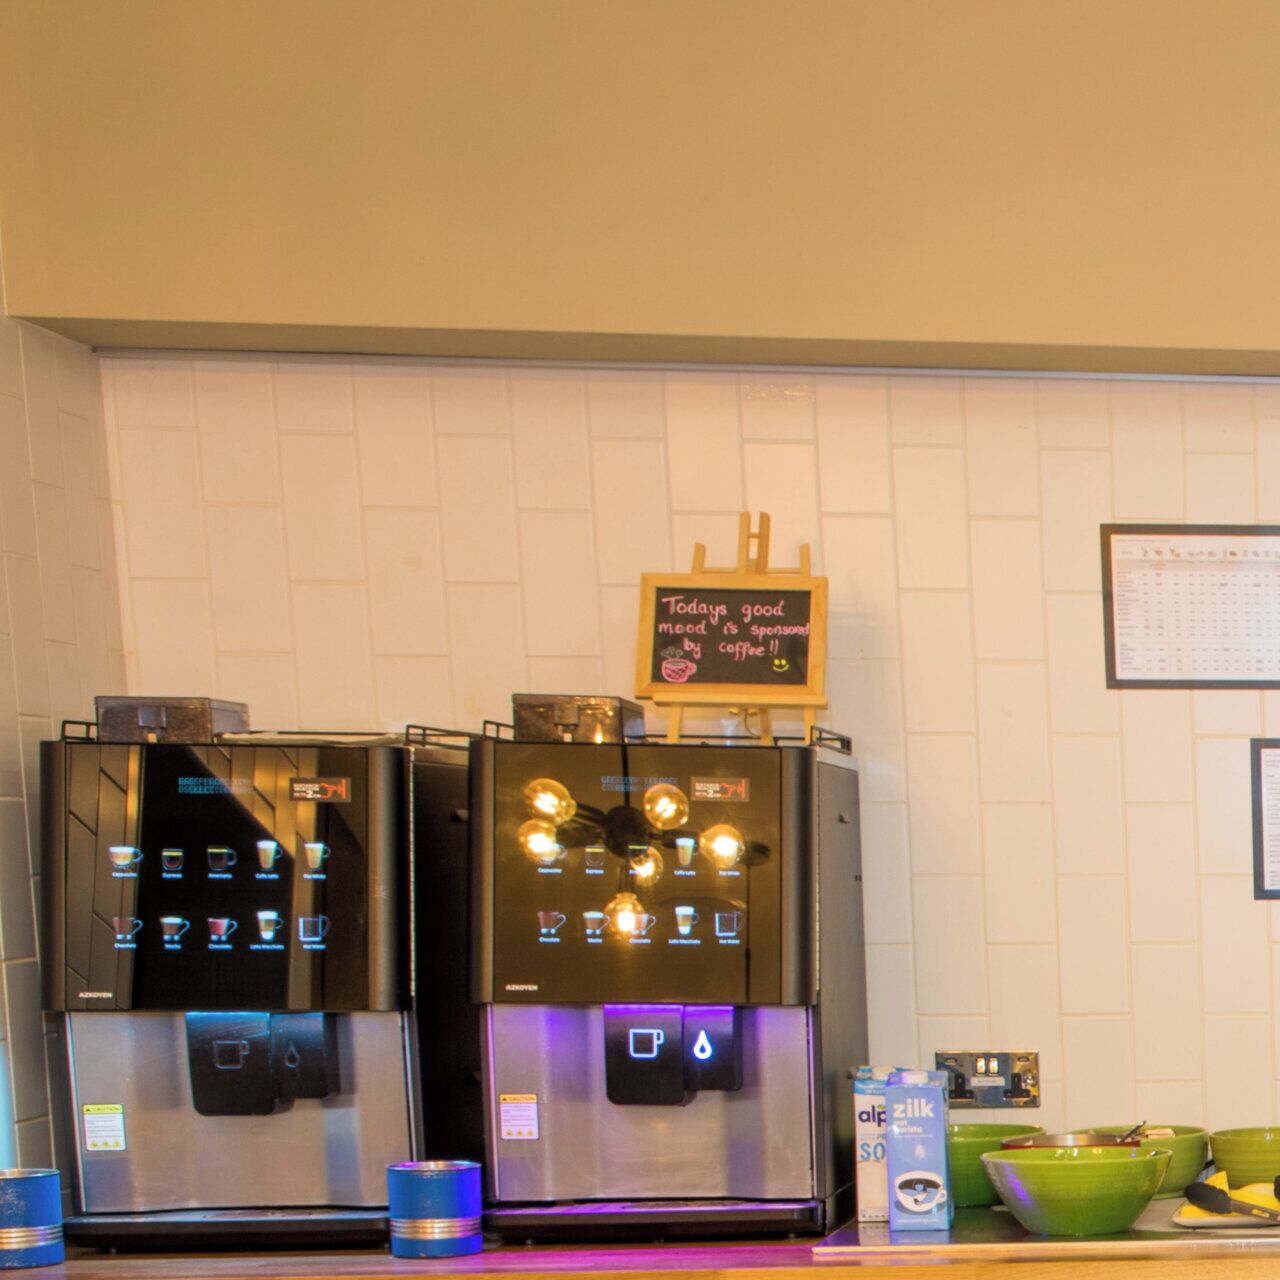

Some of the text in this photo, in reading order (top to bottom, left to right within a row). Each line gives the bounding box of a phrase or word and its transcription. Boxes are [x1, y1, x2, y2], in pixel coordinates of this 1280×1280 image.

[661, 595, 785, 625] Todays good
[659, 620, 707, 636] mood
[723, 621, 738, 635] is
[683, 637, 701, 659] by
[858, 1104, 887, 1128] alp
[892, 1098, 935, 1118] zilk
[860, 1142, 886, 1162] SO
